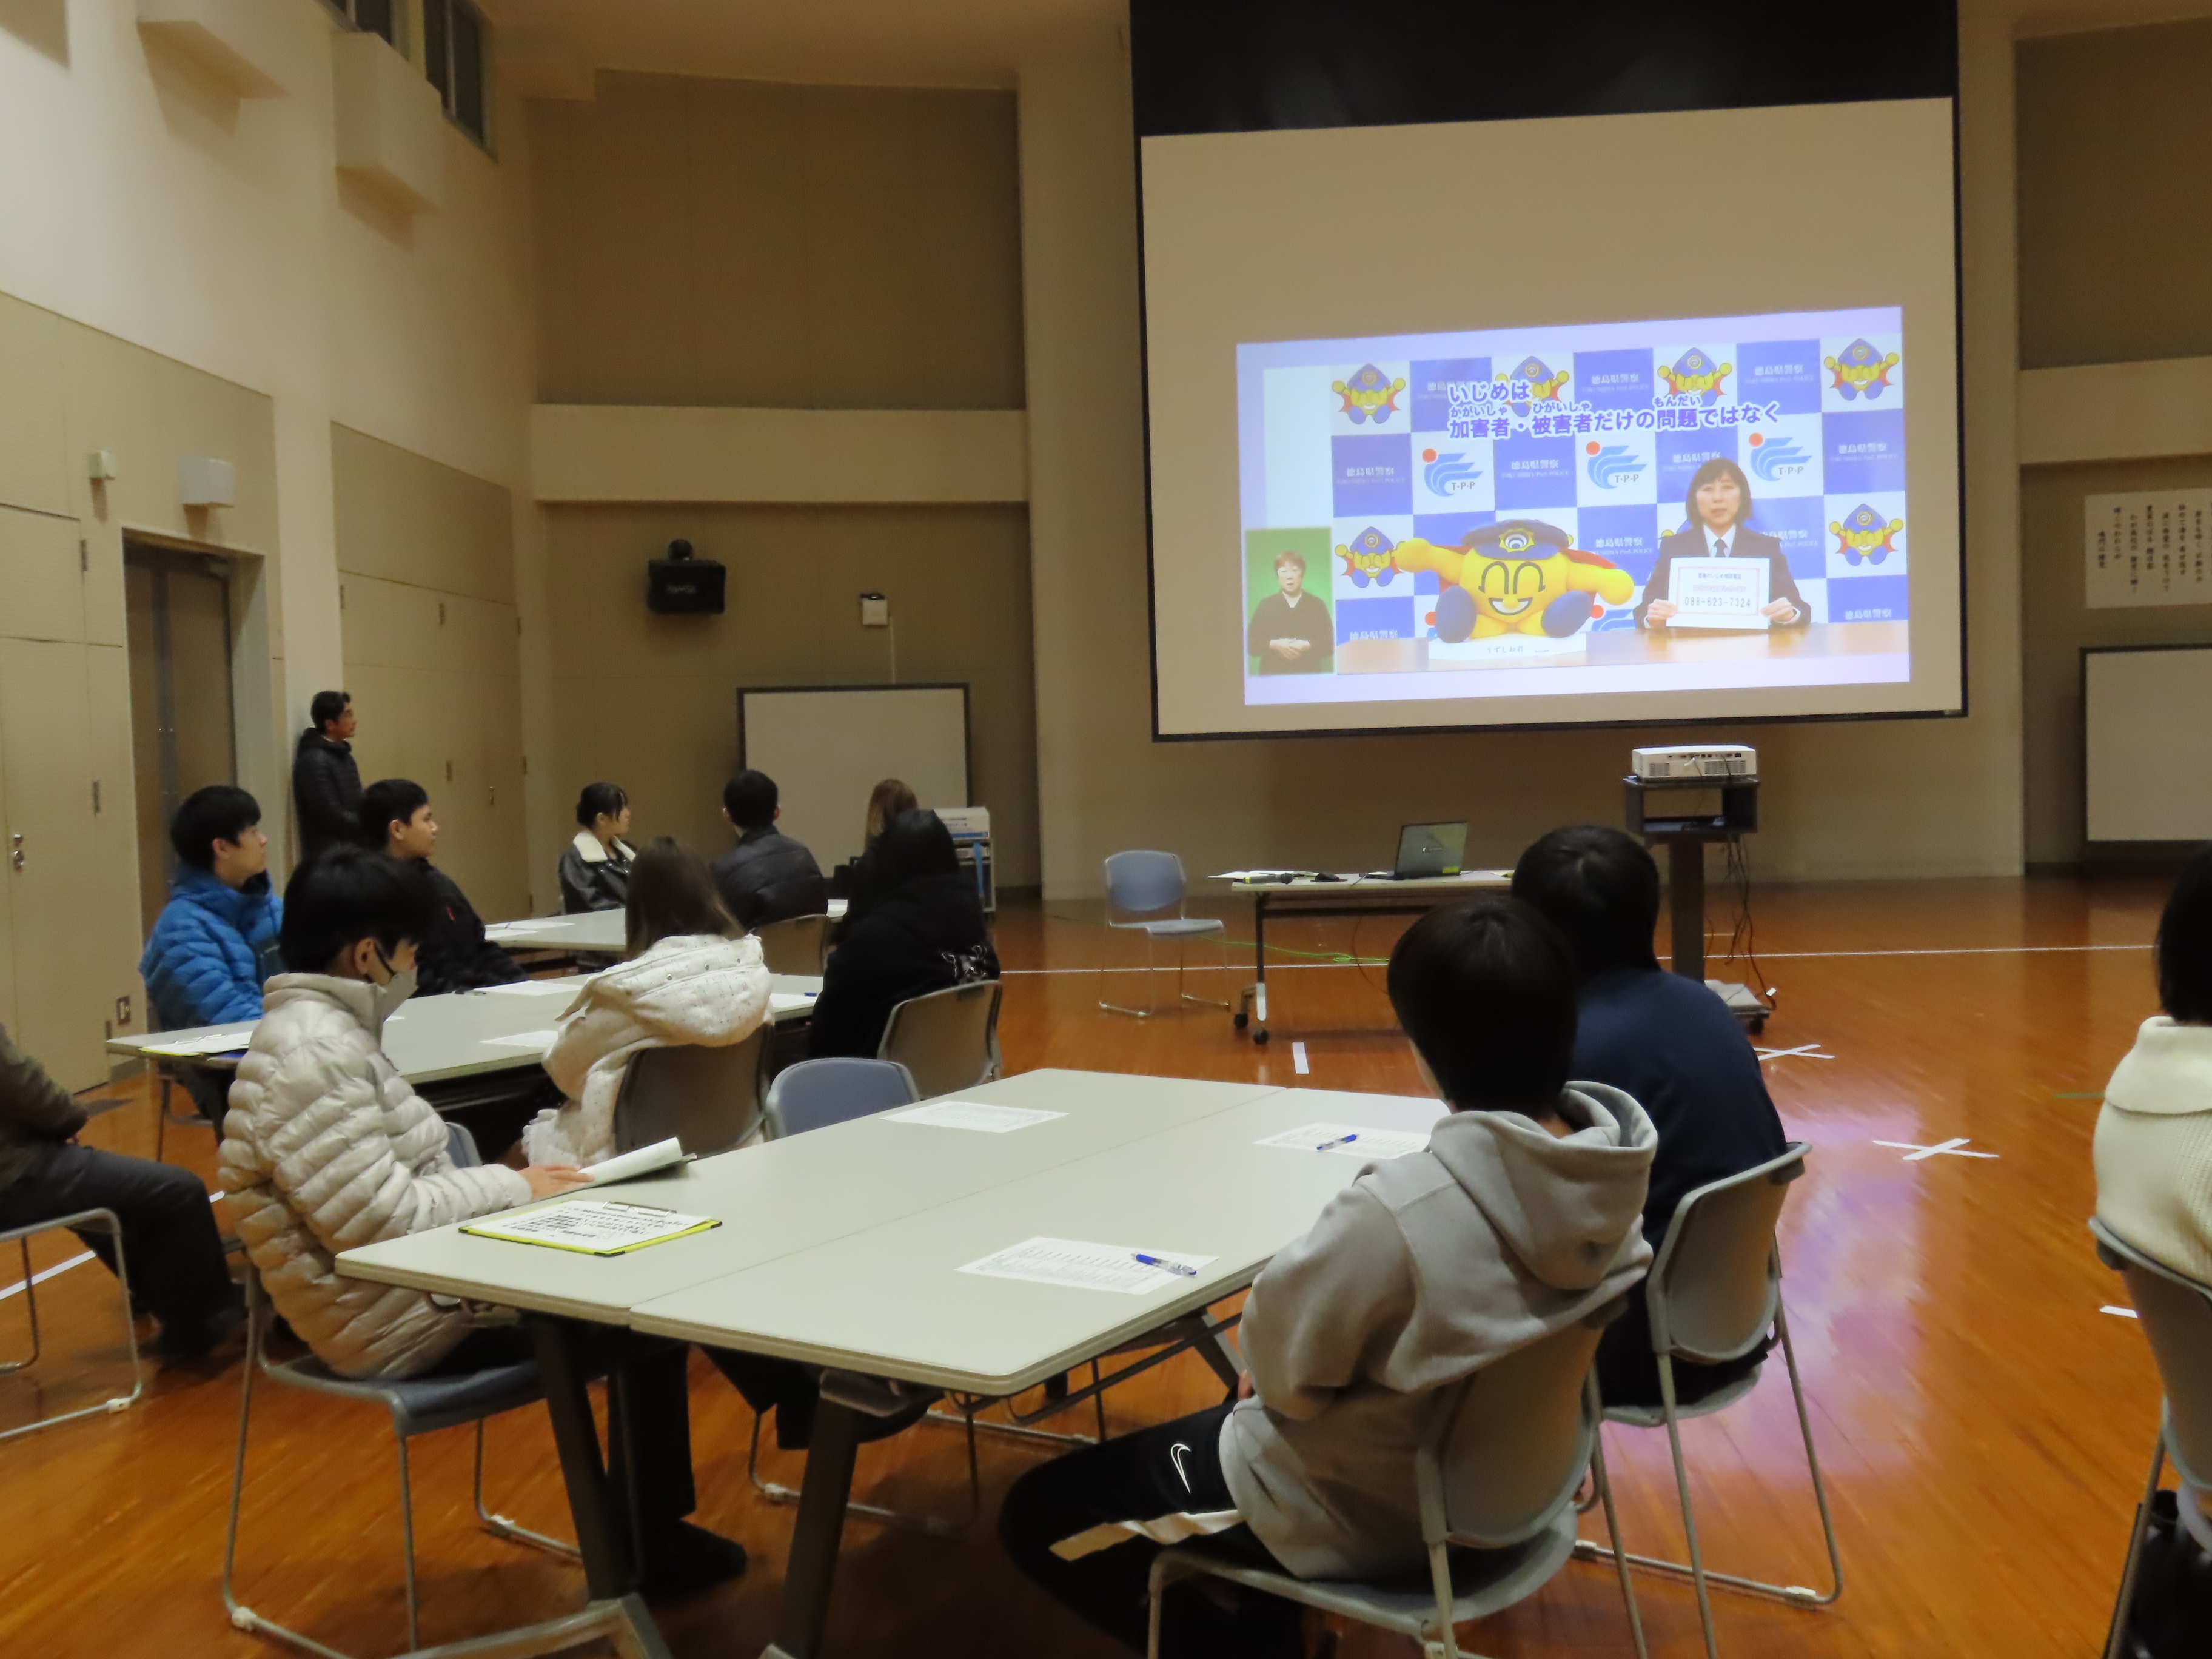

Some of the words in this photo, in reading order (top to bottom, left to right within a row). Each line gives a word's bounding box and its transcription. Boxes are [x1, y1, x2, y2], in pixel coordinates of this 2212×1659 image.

[1449, 382, 1530, 402] いじめは
[1654, 395, 1701, 407] もんだい
[1450, 406, 1507, 418] かがいしゃ
[1532, 401, 1590, 414] ひがいしゃ
[1449, 403, 1779, 438] 加害者・被害者だけの問題ではなく
[1684, 597, 1751, 607] 088-623-7324
